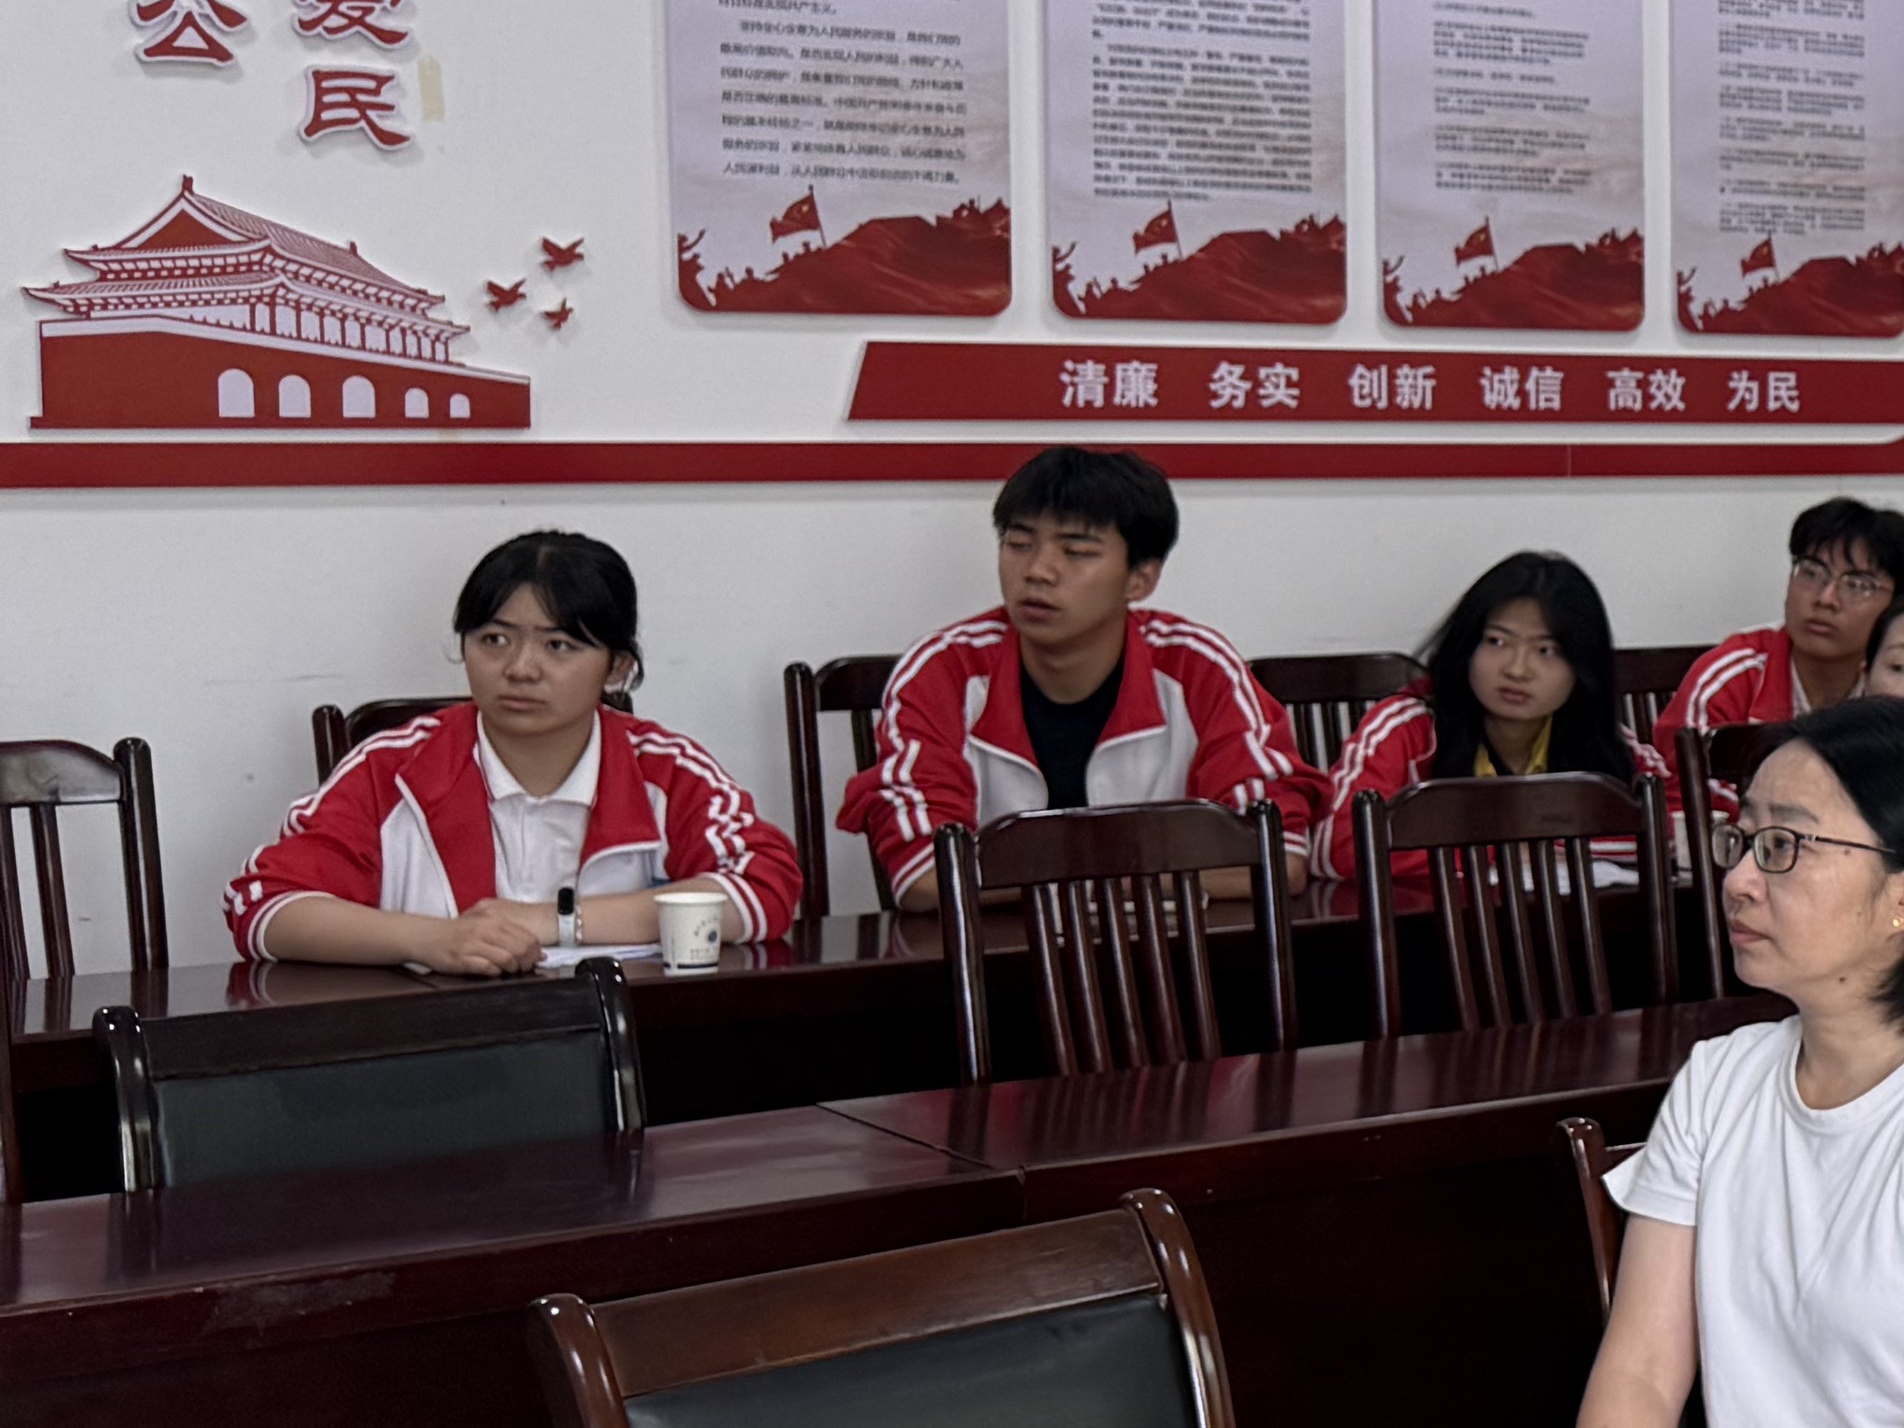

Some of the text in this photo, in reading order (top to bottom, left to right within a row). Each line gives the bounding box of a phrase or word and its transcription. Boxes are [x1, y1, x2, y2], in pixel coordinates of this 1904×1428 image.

[1061, 360, 1799, 411] 清廉 务实 创新 诚信 高效 为民
